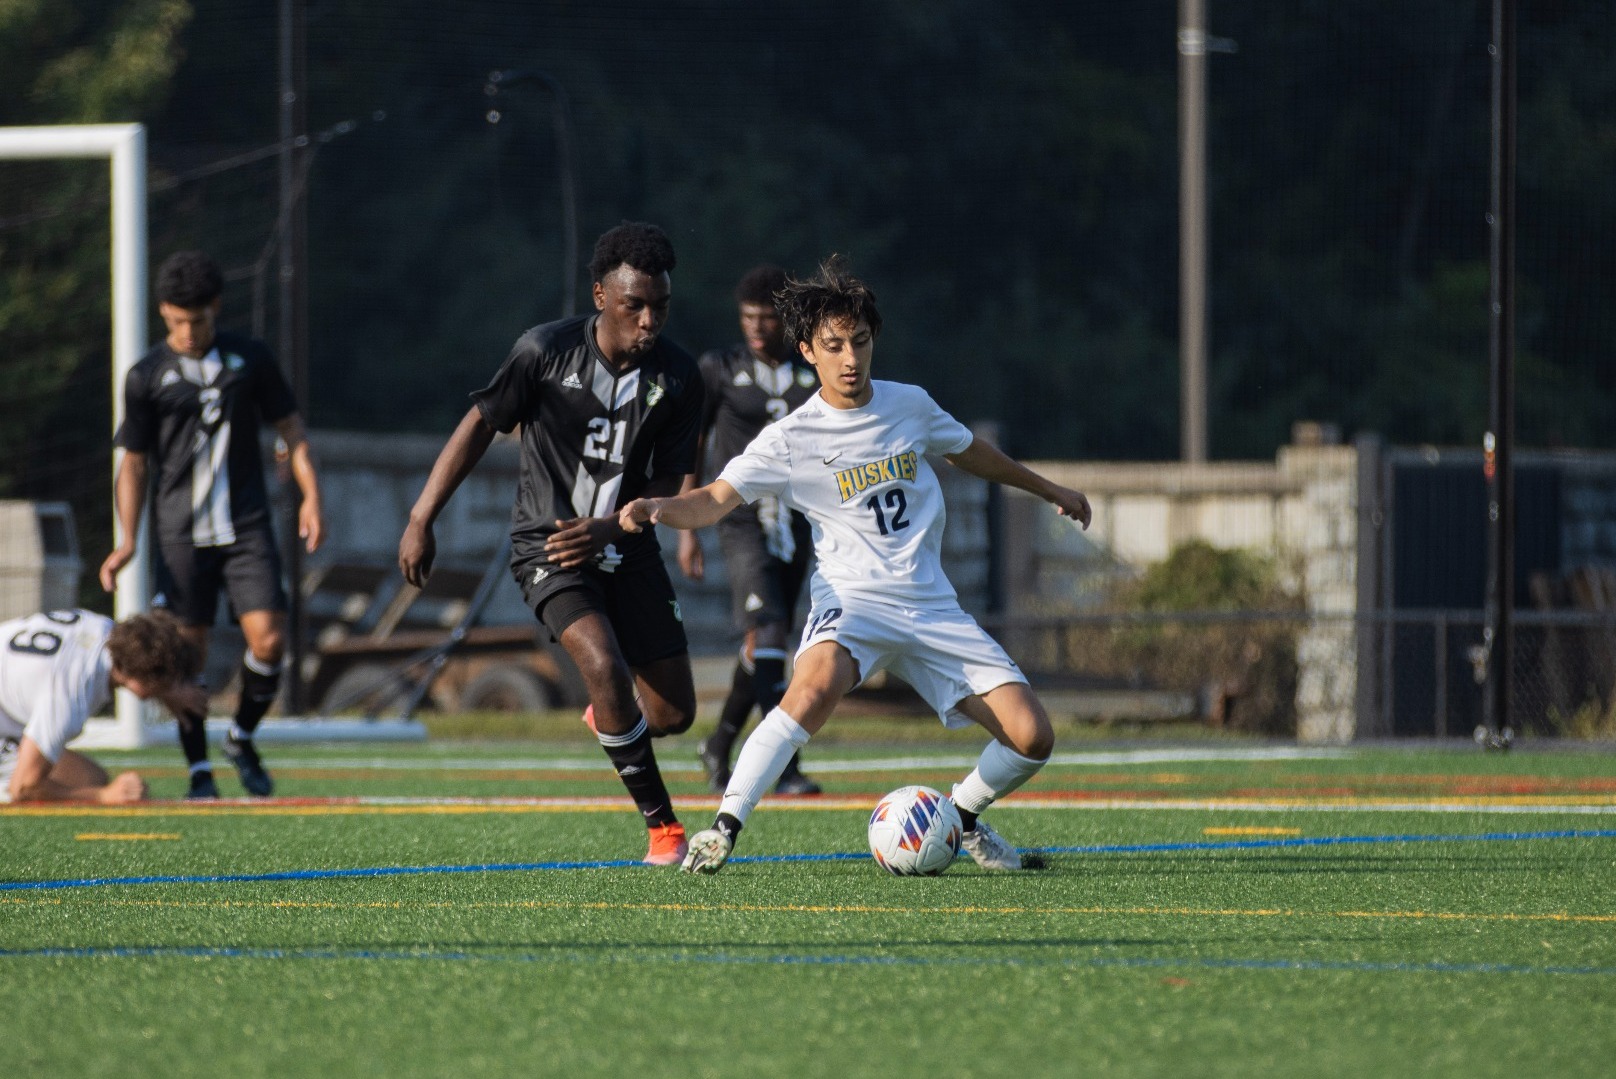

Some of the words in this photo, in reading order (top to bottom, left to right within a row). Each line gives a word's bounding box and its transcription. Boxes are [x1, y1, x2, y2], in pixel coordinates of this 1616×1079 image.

[583, 416, 627, 465] 21
[834, 451, 917, 503] HUSKIES
[867, 488, 910, 536] 12
[806, 607, 843, 643] 12
